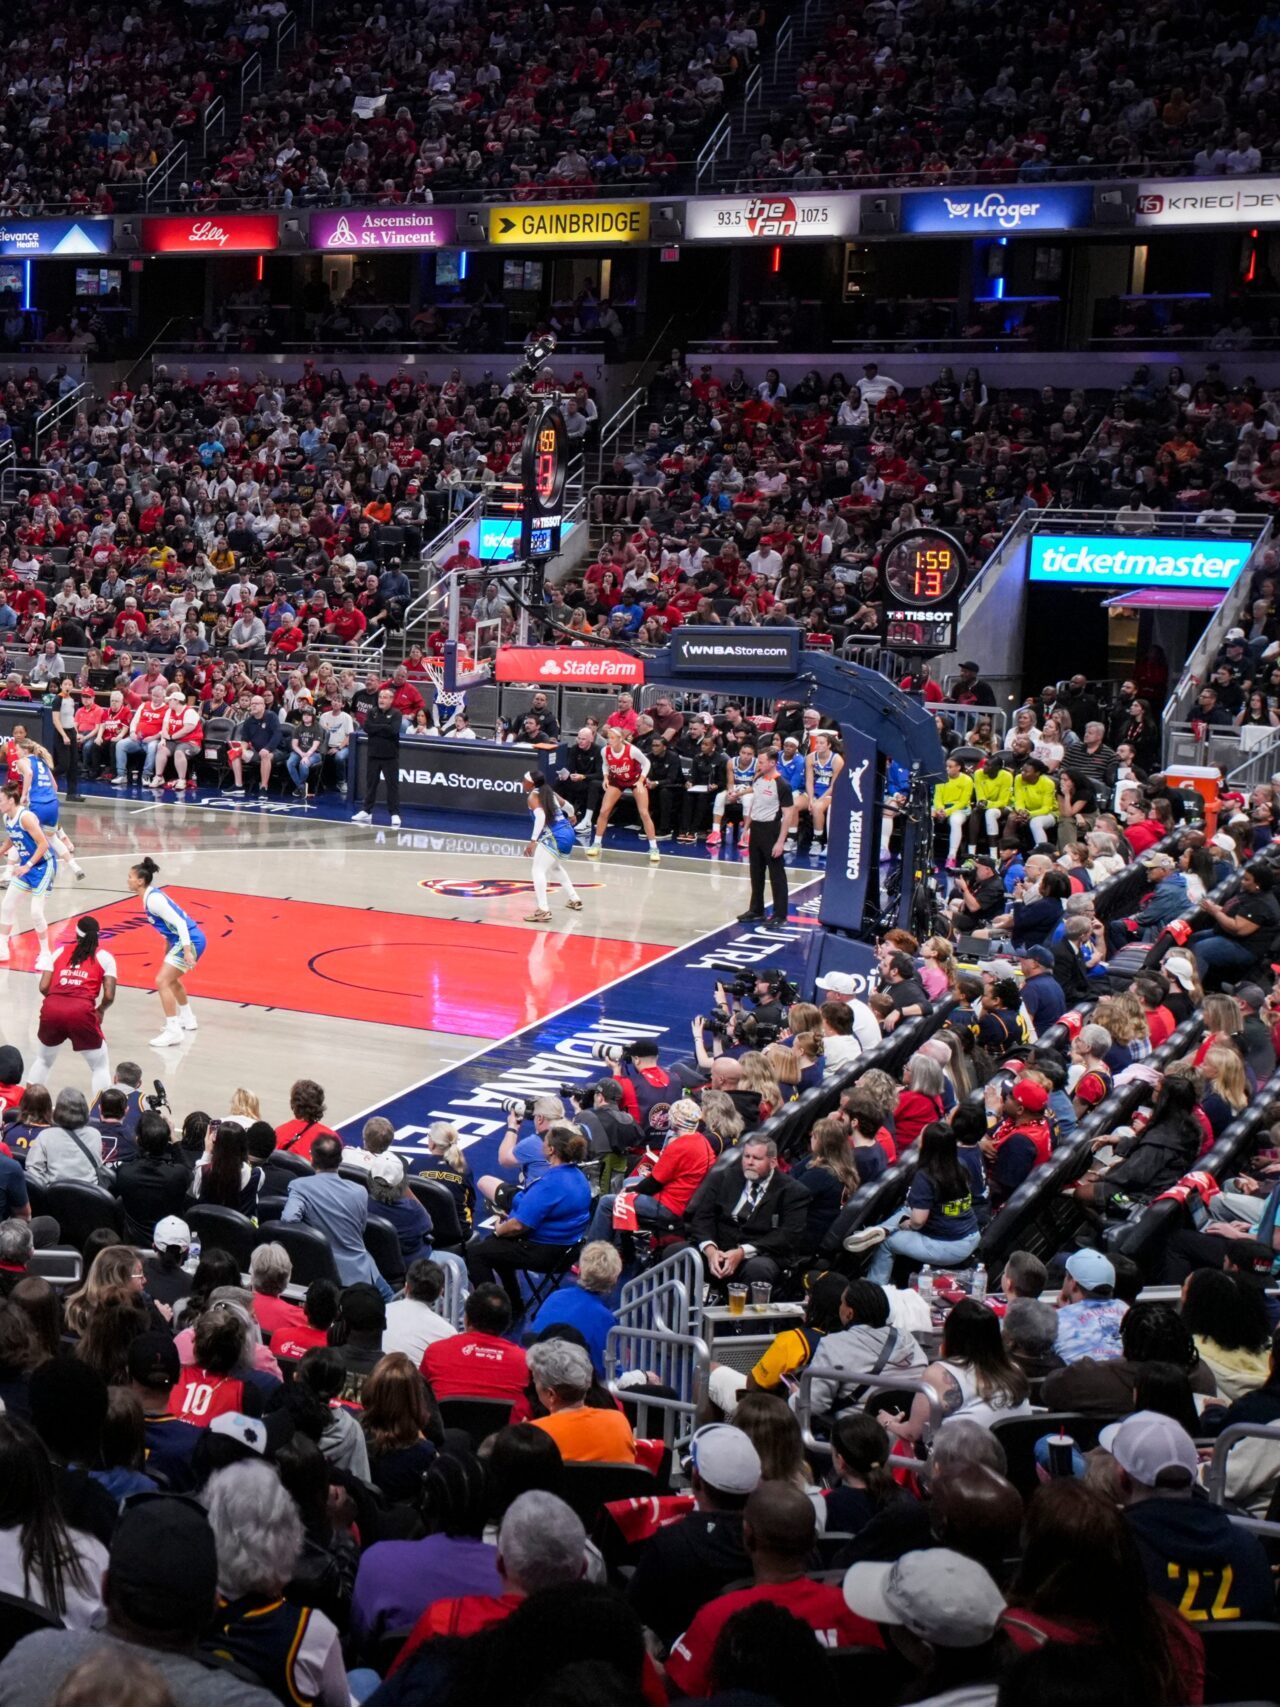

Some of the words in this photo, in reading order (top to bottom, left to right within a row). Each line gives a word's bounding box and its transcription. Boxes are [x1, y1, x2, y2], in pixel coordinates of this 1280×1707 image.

[745, 198, 785, 219] the
[973, 193, 1040, 227] Kroger
[1168, 196, 1234, 210] KRIEG
[362, 215, 434, 229] Ascension
[522, 212, 640, 235] GAINBRIDGE
[718, 212, 741, 226] 93.5
[800, 208, 828, 223] 107.5
[188, 222, 230, 246] Lilly
[754, 218, 798, 237] fan
[16, 240, 40, 249] Health
[361, 232, 378, 245] St.
[380, 230, 436, 245] Vincent
[916, 551, 951, 570] 1:59
[1042, 546, 1240, 579] ticketmaster
[914, 571, 942, 596] 13
[904, 612, 954, 622] TISSOT
[690, 645, 788, 657] WNBAStore.com
[449, 1018, 671, 1109] INDIANA
[418, 1170, 463, 1185] FEVER
[181, 1381, 213, 1416] 10
